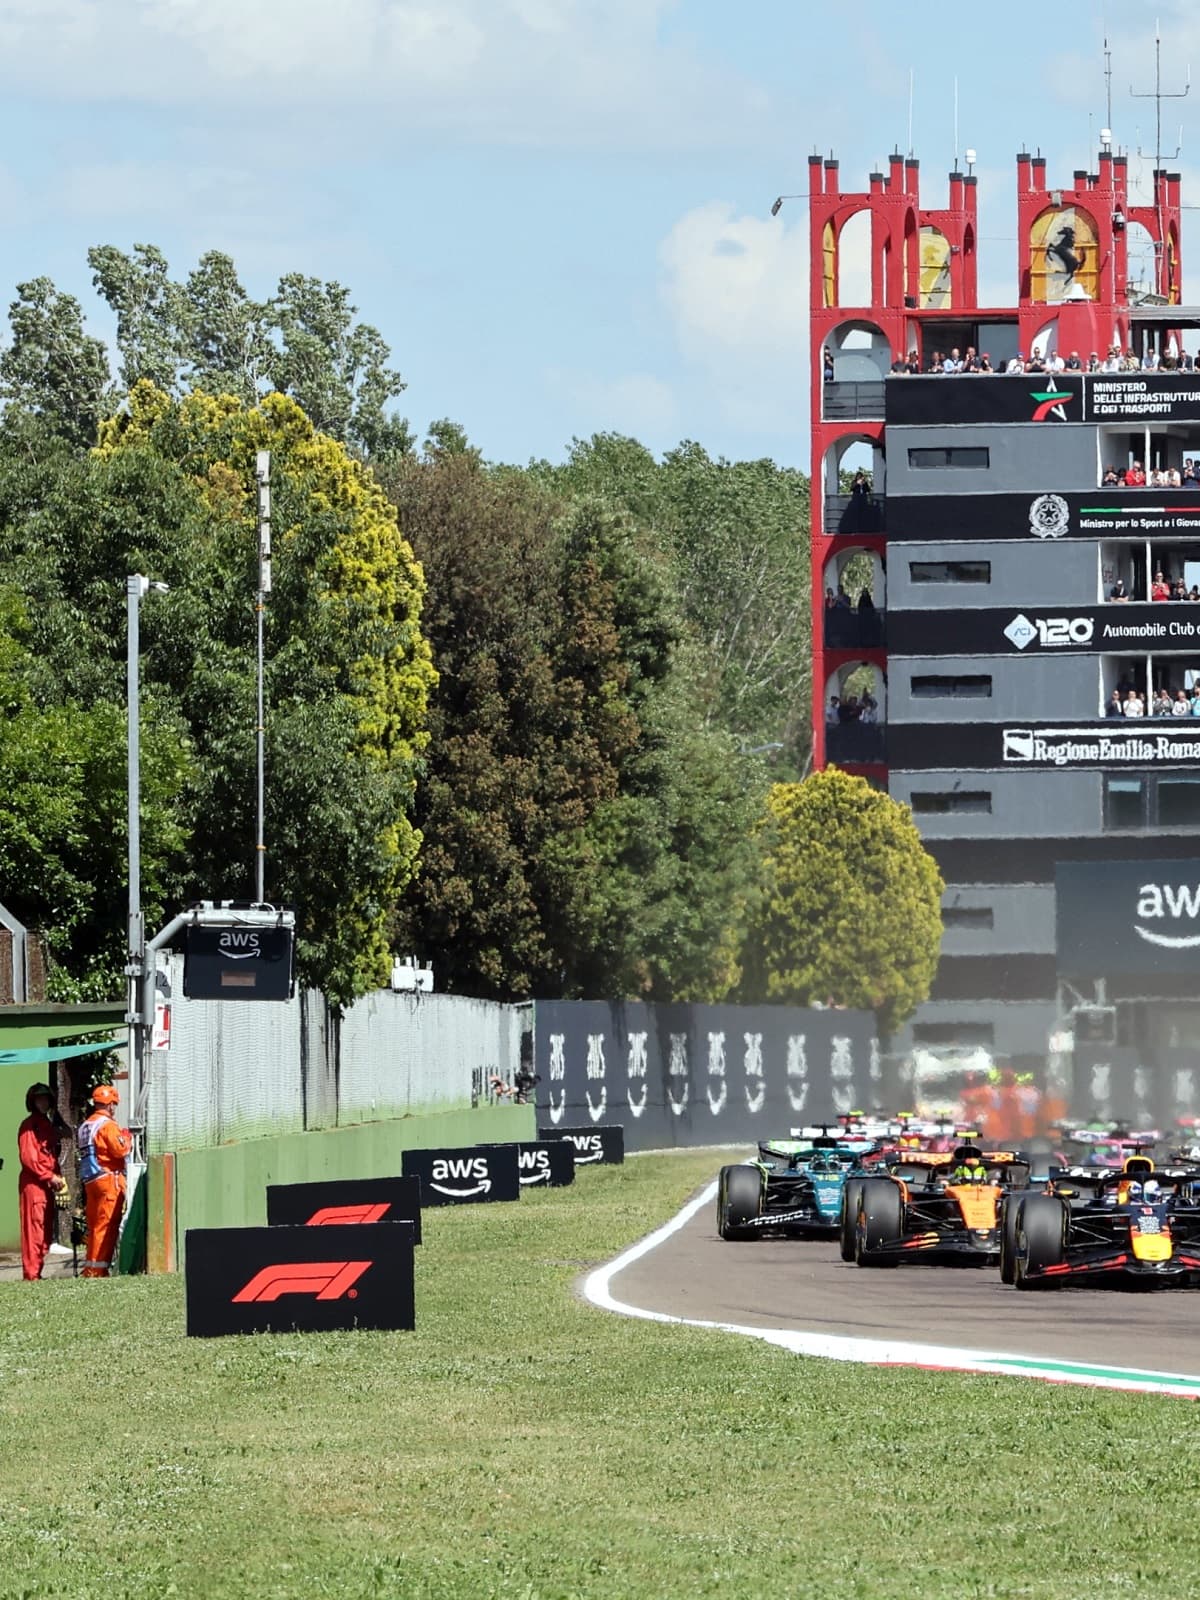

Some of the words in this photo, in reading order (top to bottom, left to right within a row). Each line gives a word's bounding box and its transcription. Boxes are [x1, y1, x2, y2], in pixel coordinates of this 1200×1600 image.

[1093, 382, 1147, 393] MINISTERO
[1093, 394, 1122, 403] DELLE
[1093, 405, 1100, 413] E
[1101, 405, 1118, 413] DEI
[1119, 403, 1171, 413] TRASPORTI
[1080, 519, 1113, 528] Ministro
[1115, 520, 1129, 530] per
[1140, 518, 1163, 529] Sport
[1103, 622, 1167, 638] Automobile
[1169, 621, 1195, 636] Club
[220, 932, 260, 947] aws
[519, 1150, 550, 1169] ws
[432, 1157, 489, 1181] aws
